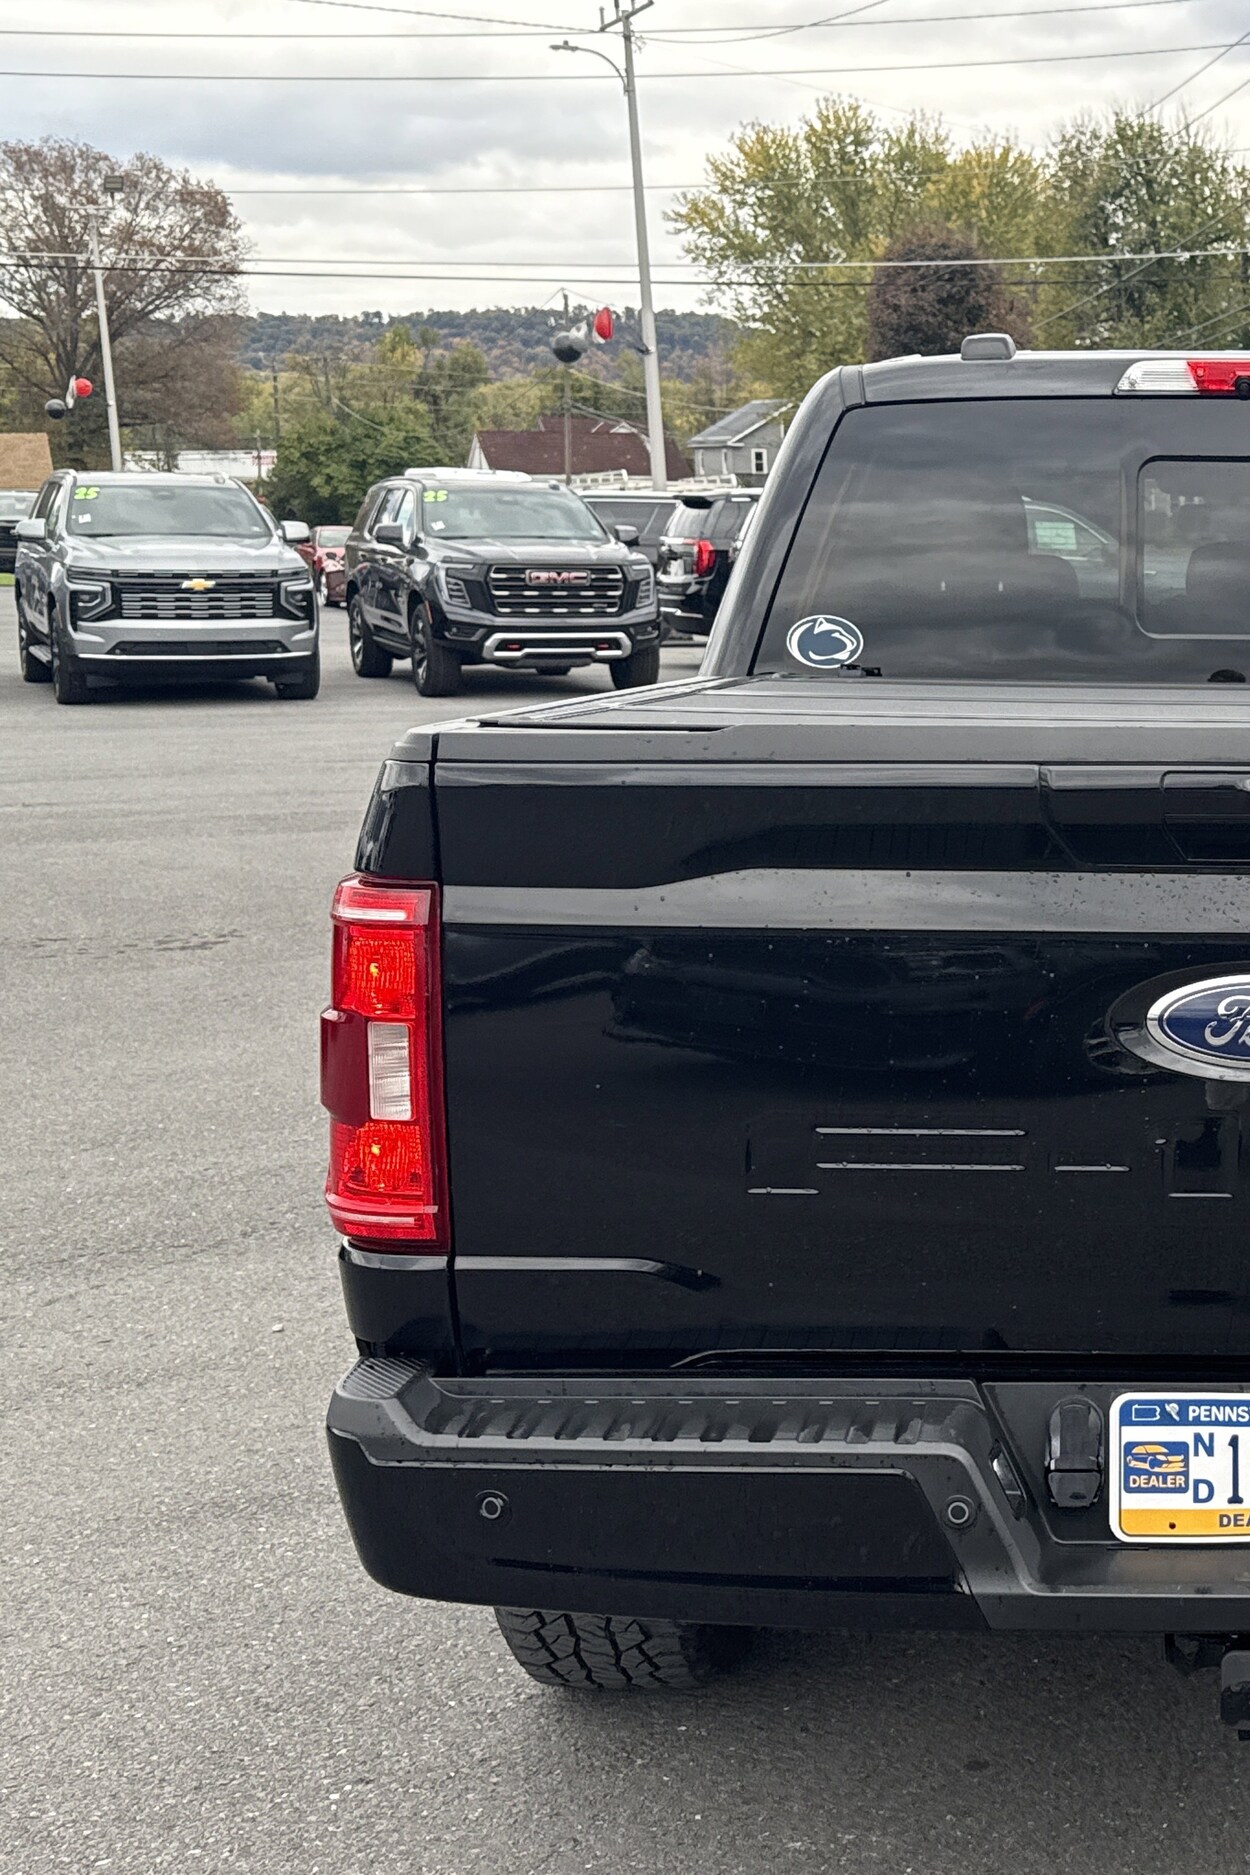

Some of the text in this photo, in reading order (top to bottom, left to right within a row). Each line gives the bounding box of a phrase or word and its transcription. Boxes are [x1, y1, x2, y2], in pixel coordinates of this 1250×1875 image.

[73, 486, 101, 500] 25
[422, 489, 448, 502] 25
[530, 571, 588, 584] GMC
[1129, 1475, 1185, 1488] DEALER
